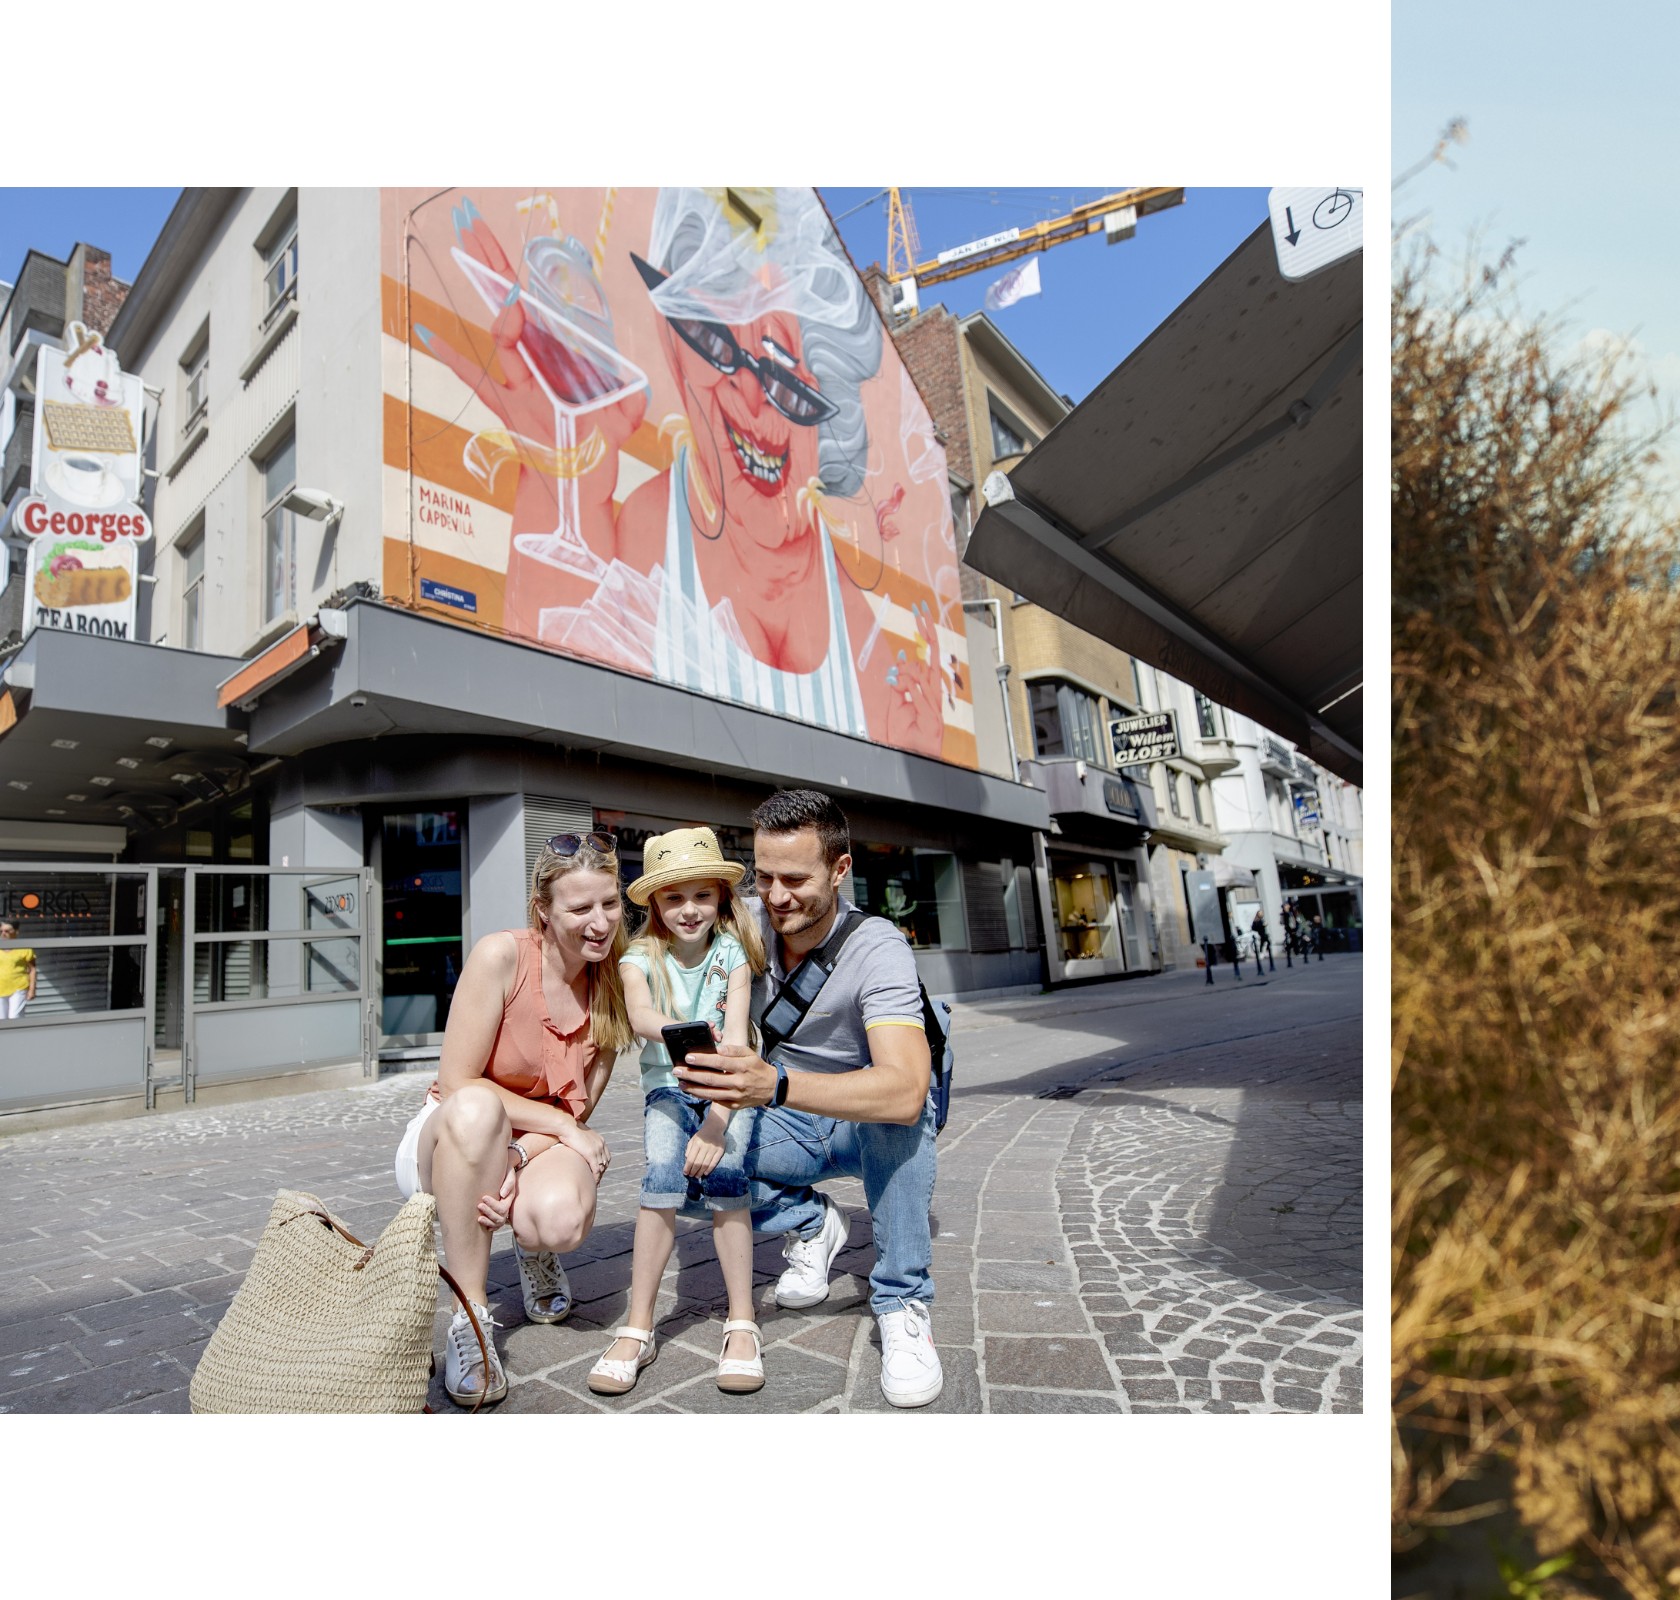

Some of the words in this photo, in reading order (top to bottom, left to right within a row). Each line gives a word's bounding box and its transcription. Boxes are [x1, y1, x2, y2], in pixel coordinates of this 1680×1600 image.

[420, 486, 472, 518] MARINA
[24, 502, 145, 543] Georges
[419, 505, 476, 538] CAPDEVILA
[1116, 714, 1168, 734] JUWELIER
[1115, 742, 1176, 764] CLOET
[1129, 731, 1174, 748] Willem
